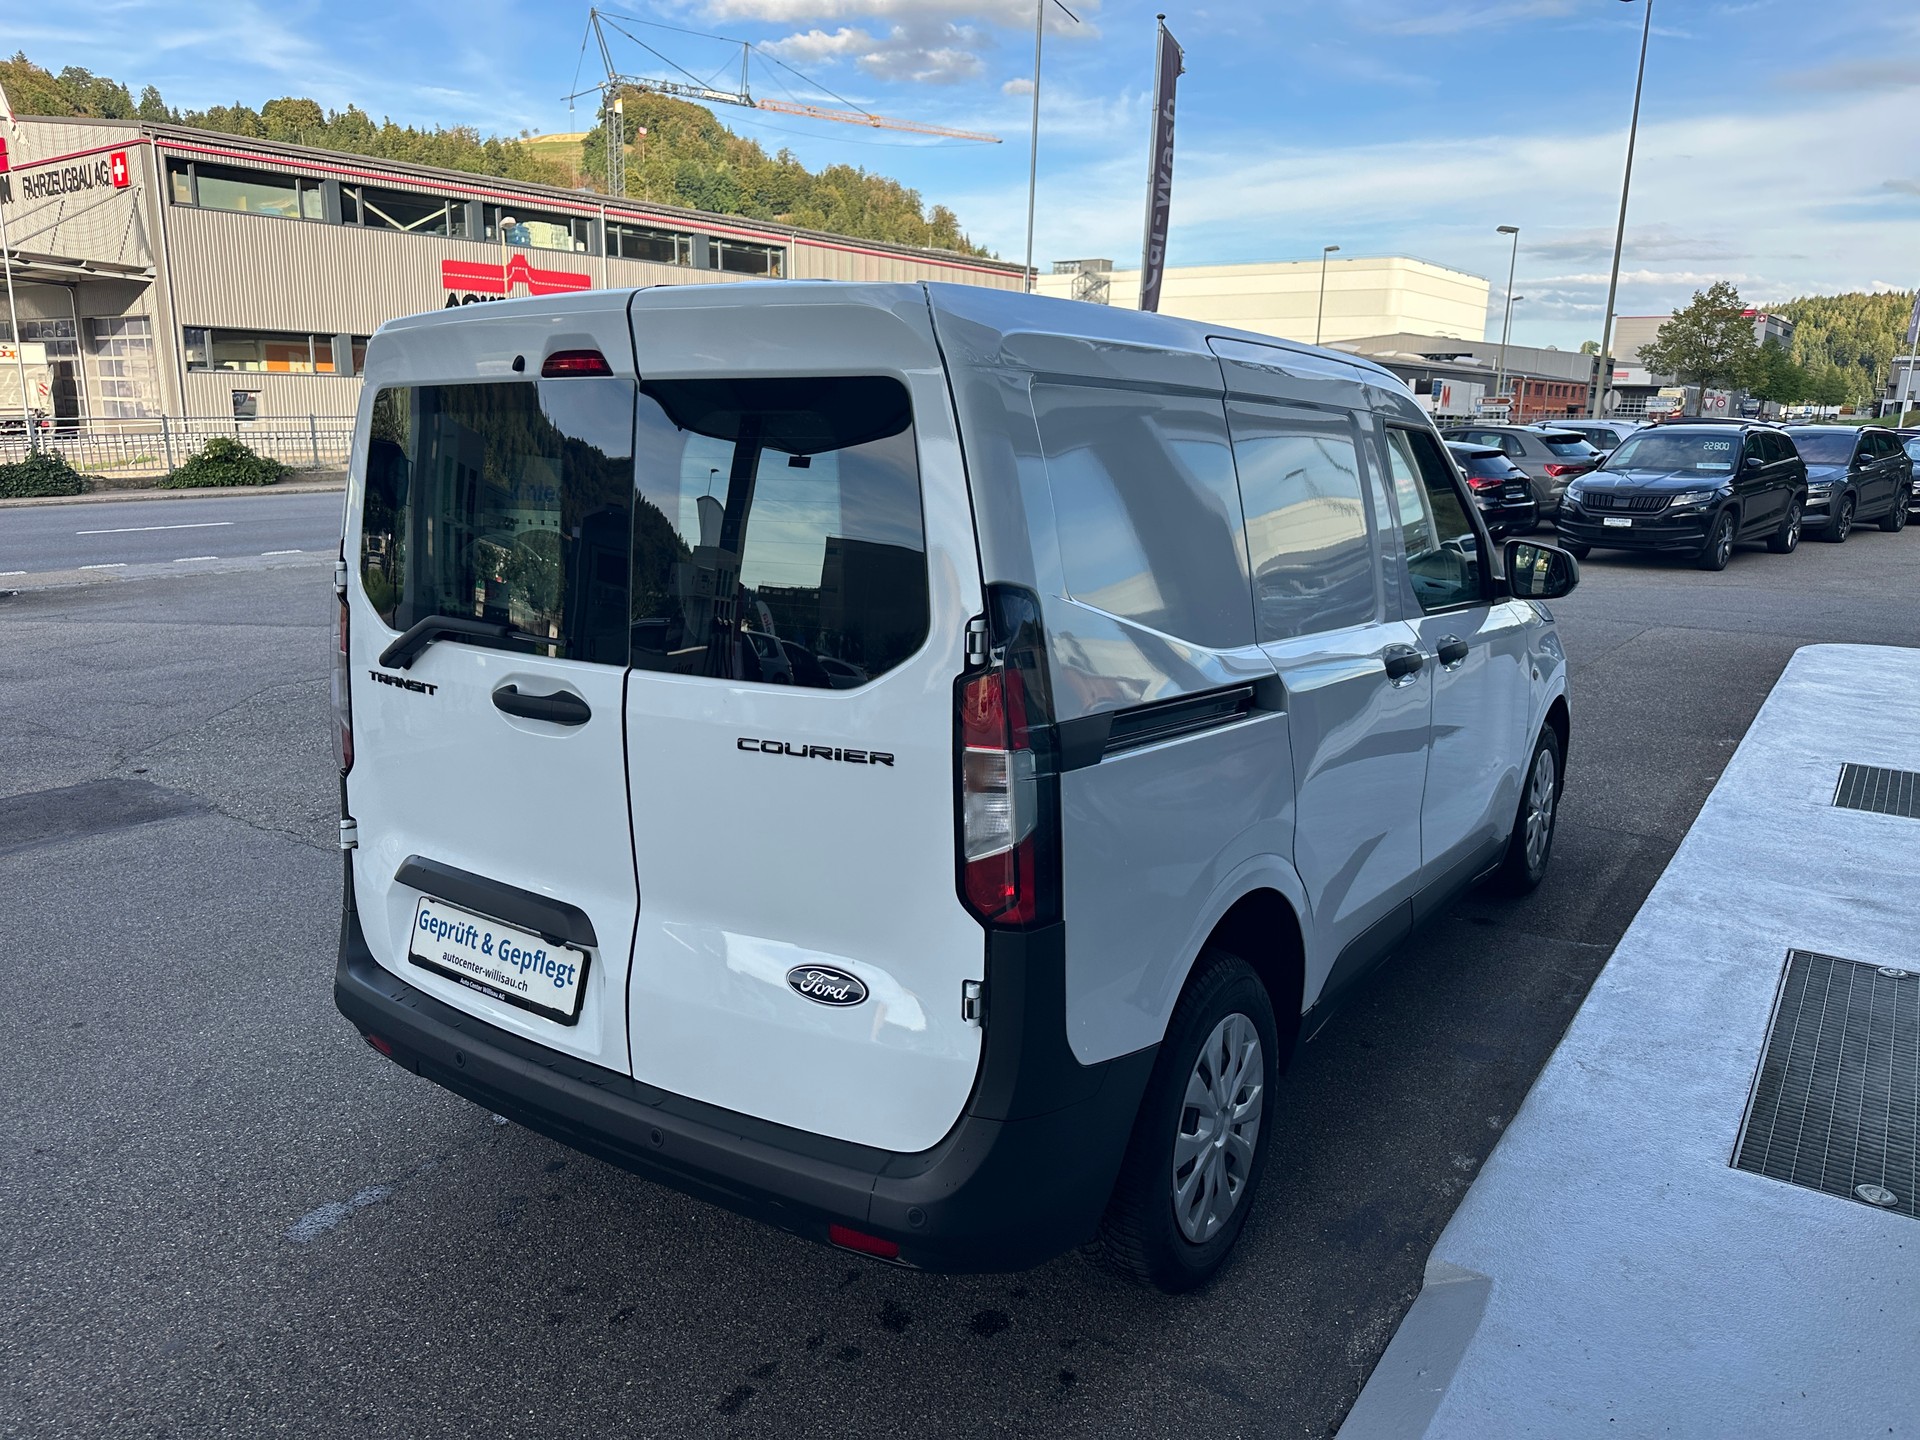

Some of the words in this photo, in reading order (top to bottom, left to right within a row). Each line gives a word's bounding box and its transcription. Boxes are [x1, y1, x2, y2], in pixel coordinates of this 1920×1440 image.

[22, 163, 93, 200] FAHRZEUGBAU
[94, 160, 112, 188] AG
[1703, 441, 1730, 451] 22800
[368, 670, 438, 696] TRANSIT
[736, 737, 895, 767] COURIER
[419, 909, 479, 950] Geprüft
[481, 932, 494, 956] &
[498, 939, 576, 988] Gepflegt
[442, 951, 528, 992] autocenter-willisau.ch
[800, 970, 851, 1001] Ford
[460, 977, 470, 987] Auto
[470, 981, 483, 991] Center
[482, 986, 499, 998] Willisau
[498, 992, 506, 1000] AG
